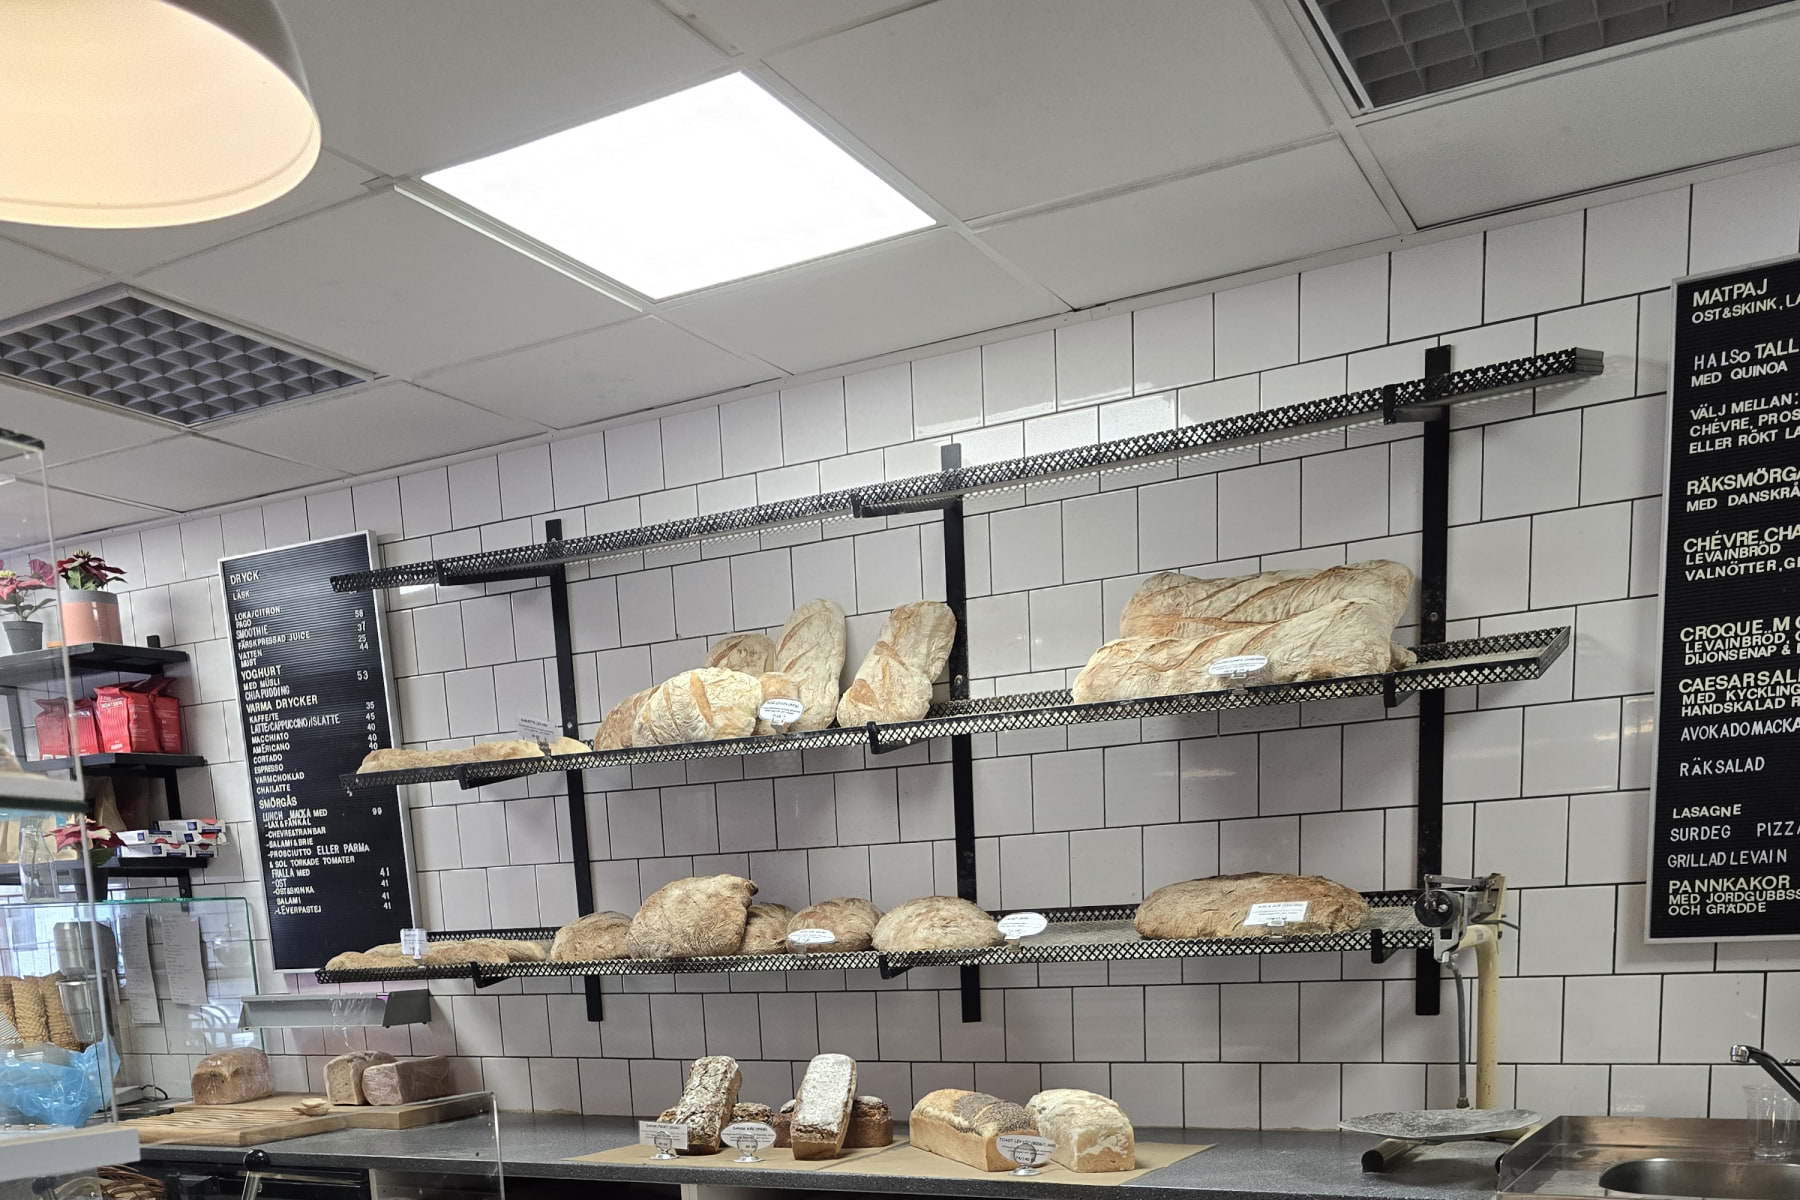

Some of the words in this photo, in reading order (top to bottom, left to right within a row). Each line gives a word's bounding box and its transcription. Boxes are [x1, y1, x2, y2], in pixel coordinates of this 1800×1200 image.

[1692, 278, 1767, 307] MATPAJ
[1754, 338, 1800, 359] TALL
[1691, 372, 1722, 387] MED
[1730, 360, 1788, 379] QUINOA
[1690, 403, 1726, 420] VÄLJ
[1731, 392, 1799, 414] MELLAN:
[1689, 437, 1732, 454] ELLER
[1738, 429, 1778, 446] RÖKT
[1686, 498, 1717, 512] MED
[1683, 529, 1759, 553] CHÉVRE
[1686, 541, 1781, 565] LEVAINBRÖD
[230, 570, 259, 585] DRYCK
[233, 589, 250, 600] LÄSK
[235, 605, 280, 620] LOKA/CITRON
[236, 619, 252, 629] PAGO
[357, 620, 366, 631] 37
[1680, 619, 1763, 642] CROQUE
[236, 624, 268, 640] SMOOTHIE
[289, 631, 311, 642] JUICE
[360, 642, 369, 650] 44
[238, 649, 263, 660] VATTEN
[1685, 645, 1777, 665] DIJONSENAP
[1781, 644, 1791, 655] &
[240, 658, 257, 668] MUST
[241, 665, 281, 680] YOGHURT
[356, 670, 369, 681] 53
[243, 681, 258, 691] MED
[260, 677, 280, 688] MÜSLI
[1682, 692, 1716, 705] MED
[1726, 683, 1800, 701] KYCKLING
[246, 701, 273, 713] VARMA
[275, 694, 318, 709] DRYCKER
[365, 701, 375, 710] 35
[1681, 697, 1786, 717] HANDSKALAD
[249, 712, 280, 724] KAFFE/TE
[365, 712, 376, 721] 45
[367, 723, 376, 731] 40
[1680, 717, 1800, 741] AVOKADOMACKA
[251, 732, 289, 744] MACCHIATO
[368, 733, 377, 742] 40
[252, 742, 290, 754] AMERICANO
[368, 741, 378, 750] 40
[253, 753, 283, 764] CORTADO
[254, 763, 284, 774] ESPRESSO
[1680, 756, 1765, 777] RÄKSALAD
[255, 771, 305, 784] VARMCHOKLAD
[259, 794, 298, 809] SMÖRGÅS
[262, 810, 284, 822] LUNCH
[289, 808, 312, 819] MACKA
[313, 808, 328, 817] MED
[371, 807, 383, 816] 99
[1672, 804, 1742, 819] LASAGNE
[1670, 825, 1731, 842] SURDEG
[316, 844, 340, 855] ELLER
[343, 842, 370, 853] PARMA
[275, 860, 288, 868] SOL
[290, 857, 320, 866] TORKADE
[322, 856, 355, 865] TOMATER
[271, 867, 295, 878] FRALLA
[296, 868, 311, 877] MED
[380, 866, 390, 877] 41
[380, 879, 389, 887] 41
[1668, 875, 1790, 893] PANNKAKOR
[276, 896, 302, 905] SALAMI
[381, 892, 390, 900] 41
[1669, 893, 1701, 905] MED
[383, 901, 392, 909] 41
[1668, 905, 1700, 916] OCH
[1706, 902, 1766, 914] GRÄDDE
